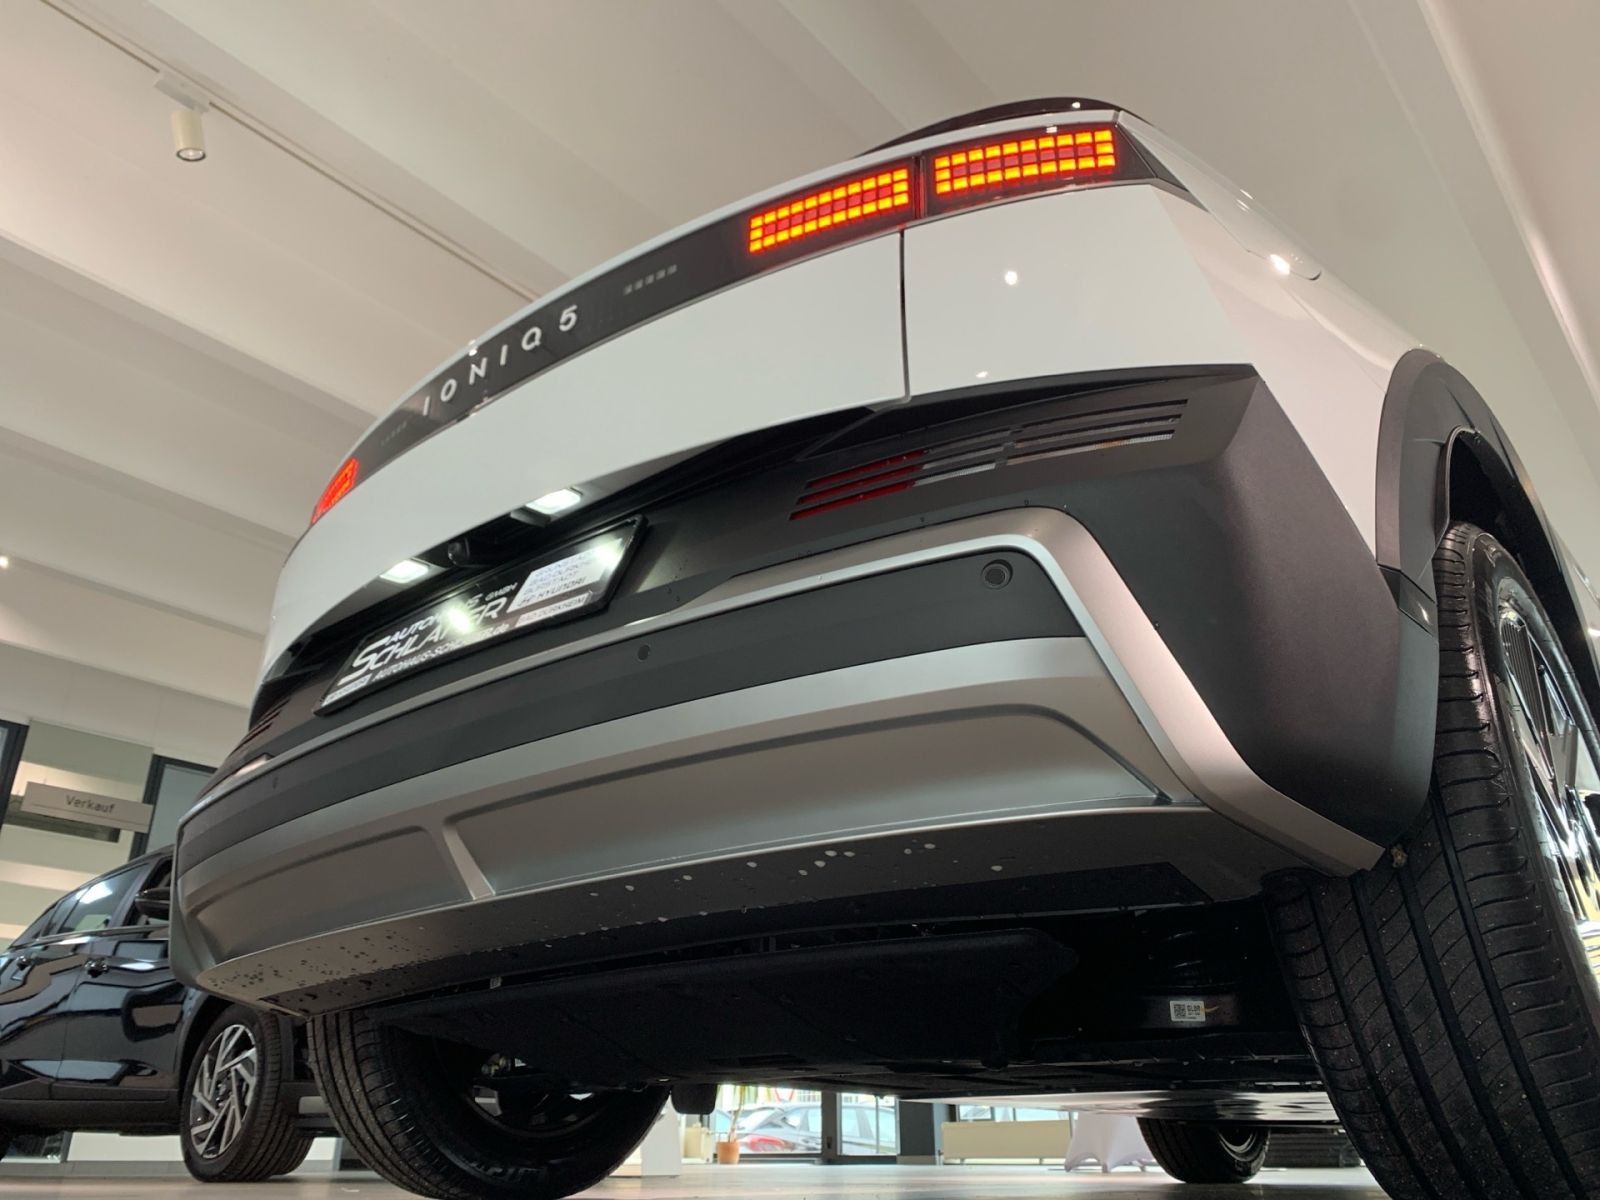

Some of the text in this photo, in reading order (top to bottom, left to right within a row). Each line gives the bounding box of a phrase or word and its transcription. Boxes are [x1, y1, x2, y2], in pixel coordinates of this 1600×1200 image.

[421, 304, 578, 417] IONIQ 5
[66, 795, 115, 814] Verkauf
